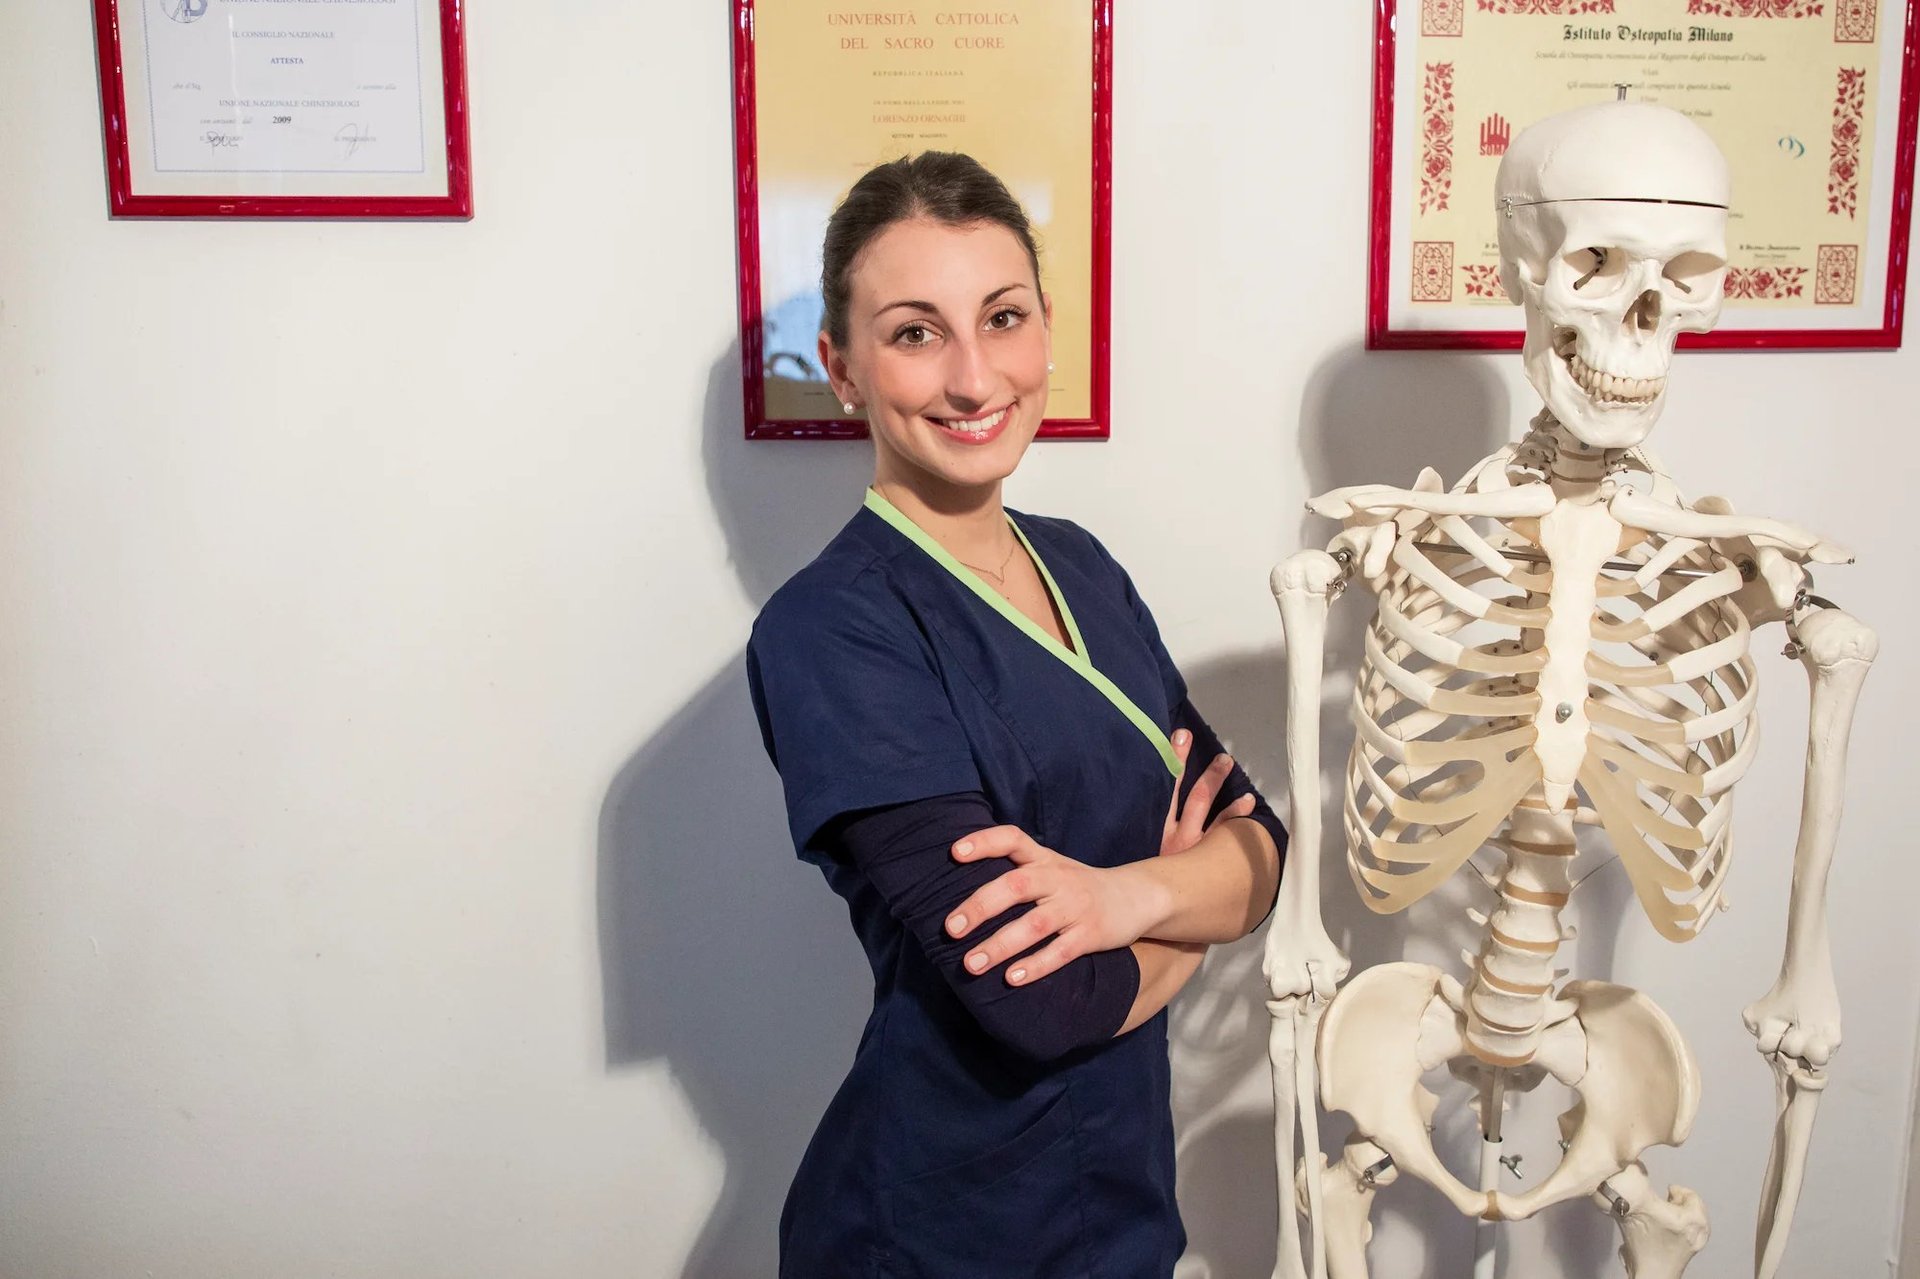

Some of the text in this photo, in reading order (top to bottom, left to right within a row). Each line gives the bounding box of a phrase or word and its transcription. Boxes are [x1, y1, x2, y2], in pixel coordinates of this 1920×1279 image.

[827, 10, 1019, 25] UNIVERSITÀ CATTOLICA
[1563, 24, 1734, 45] Istituto Osteopatia Milano
[840, 37, 1005, 49] DEL SACRO CUORE
[270, 57, 304, 65] ATTESTA
[219, 99, 250, 107] UNIONE
[253, 99, 298, 107] NAZIONALE
[272, 116, 292, 124] 2009
[873, 114, 920, 123] LORENZO
